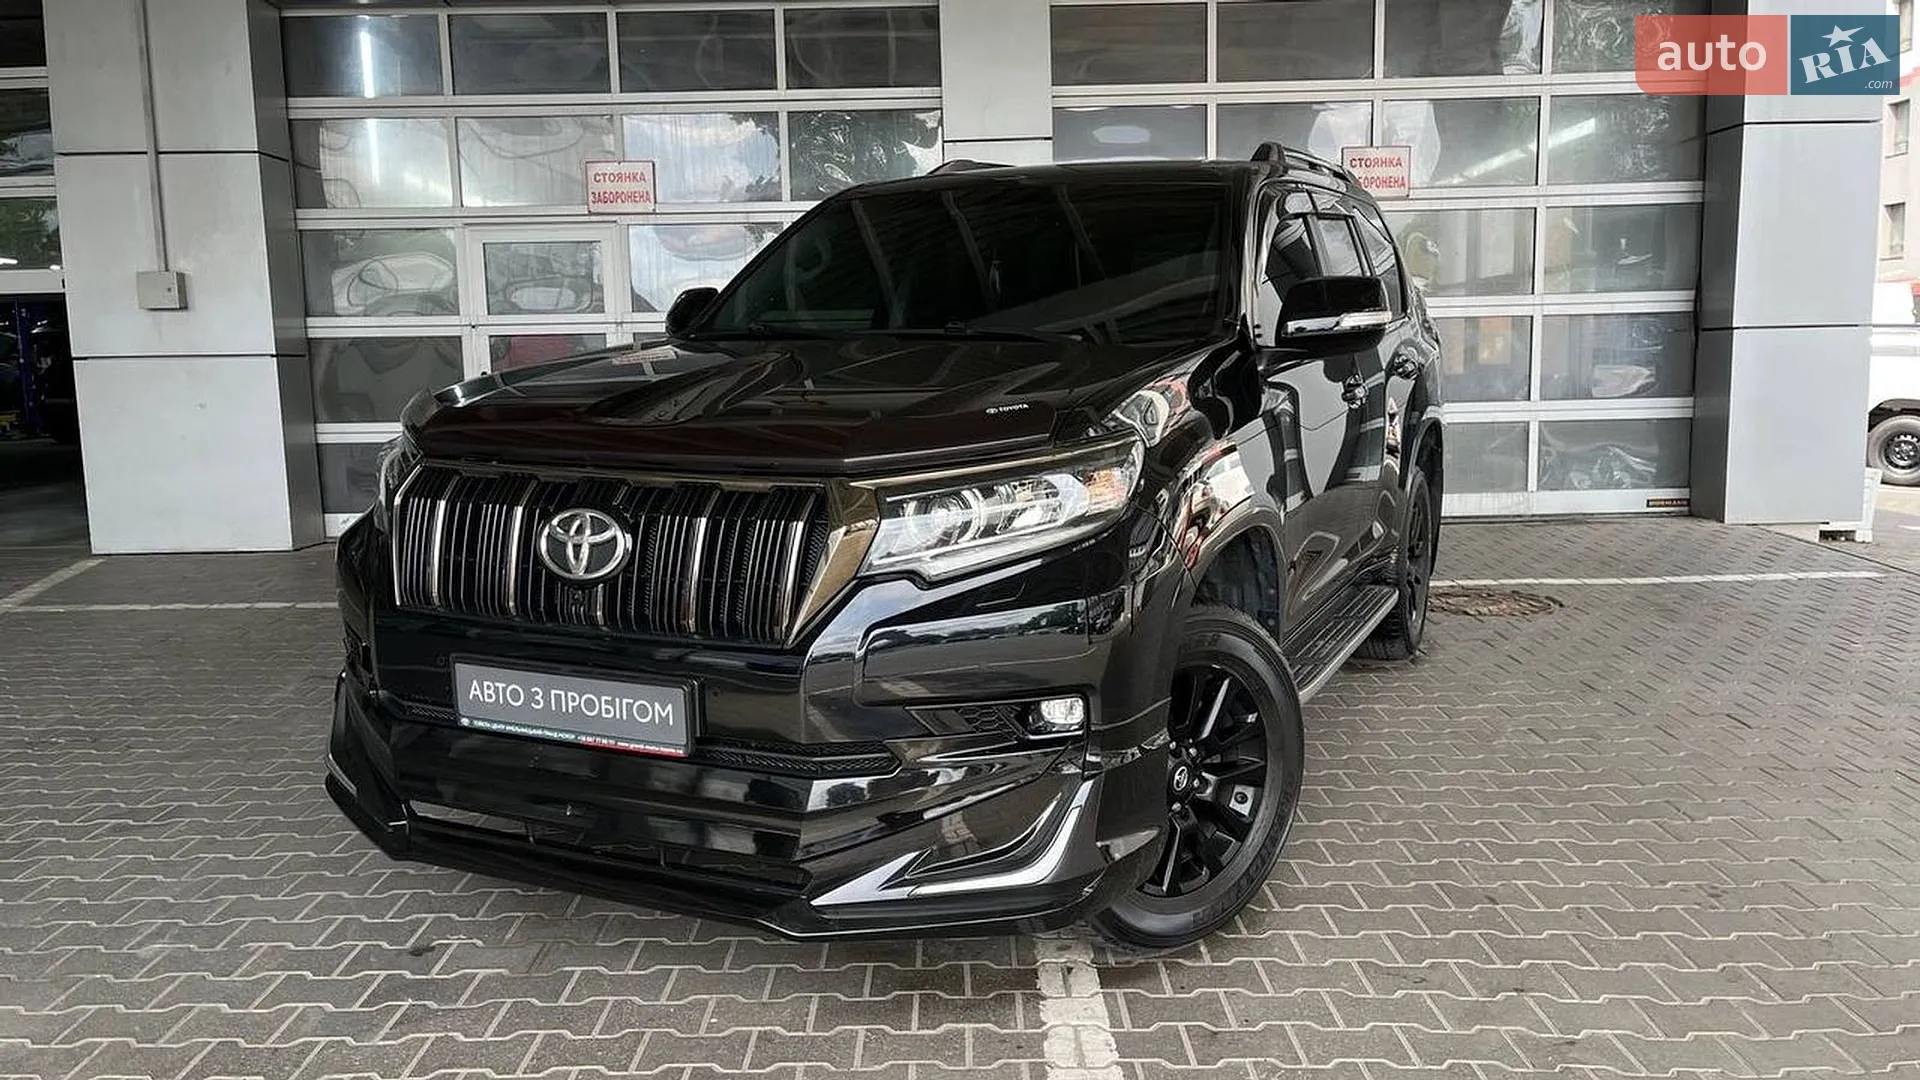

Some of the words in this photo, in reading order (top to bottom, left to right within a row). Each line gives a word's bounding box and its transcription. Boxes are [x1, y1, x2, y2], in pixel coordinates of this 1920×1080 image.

[1350, 157, 1403, 169] СТОЯНКА
[593, 172, 647, 184] СТОЯНКА
[1358, 176, 1406, 189] ОРОНЕНА
[591, 190, 652, 205] ЗАБОРОНЕНА
[999, 403, 1030, 413] TOYOTA
[469, 679, 525, 707] АВТО
[550, 689, 674, 727] ПРОБІГОМ
